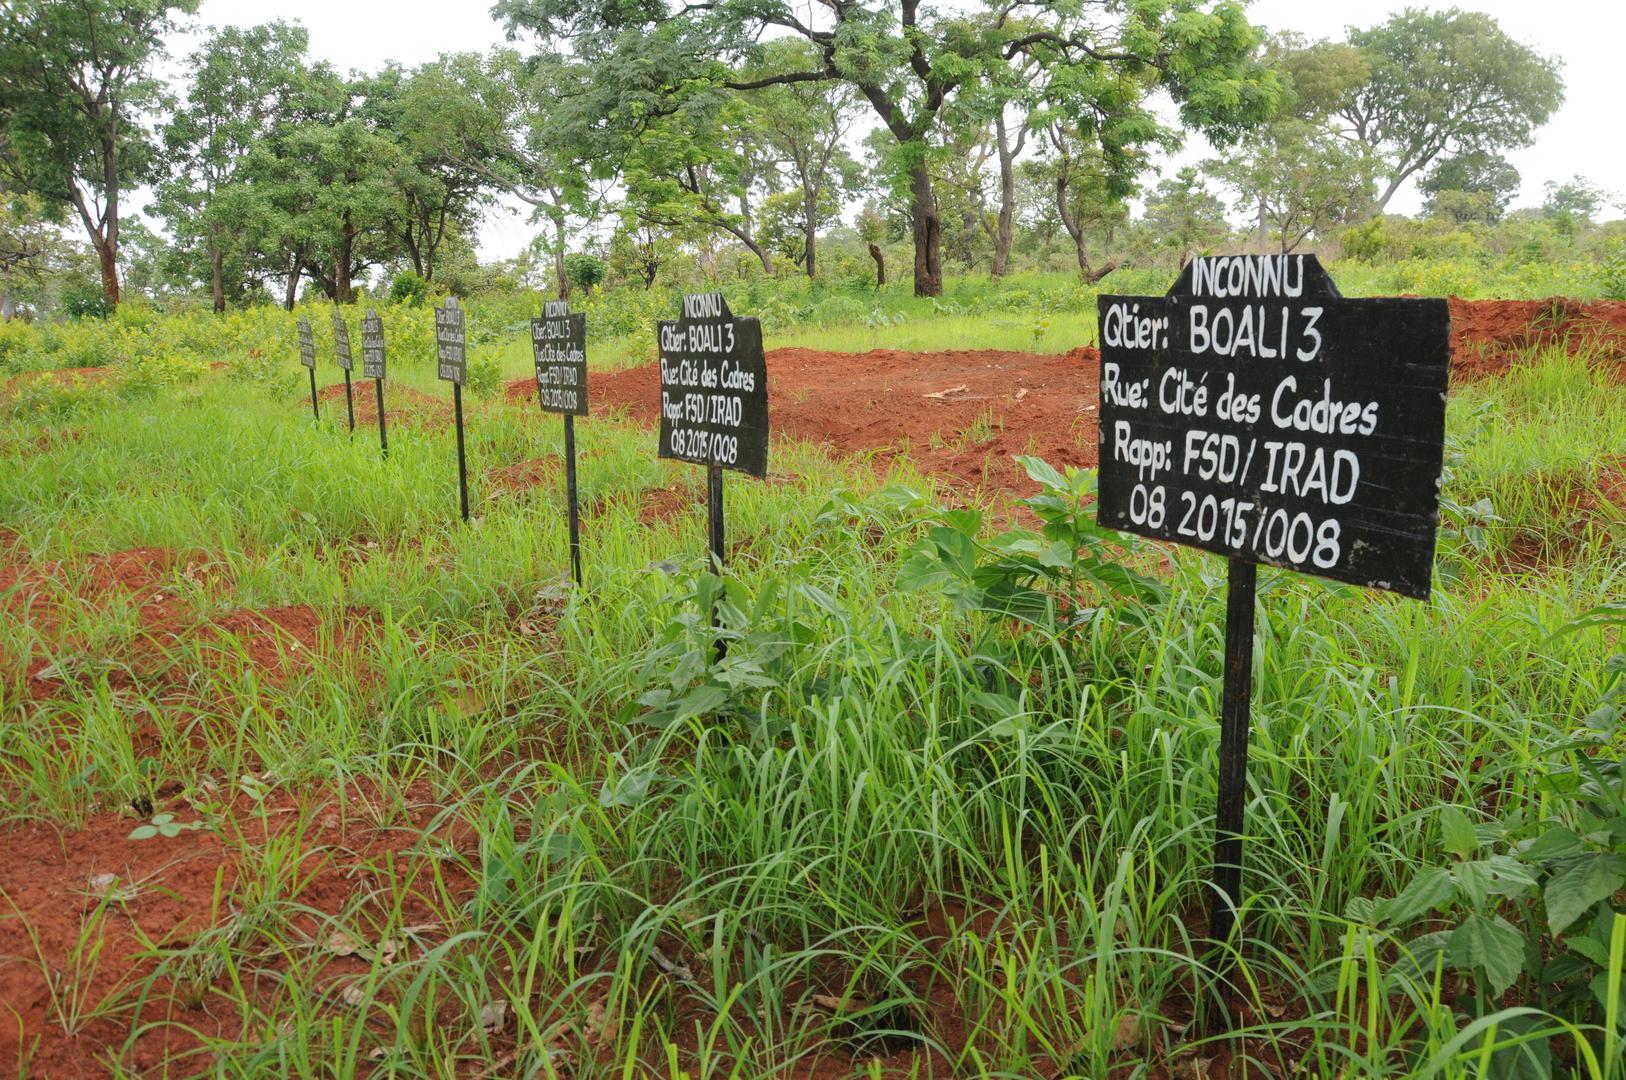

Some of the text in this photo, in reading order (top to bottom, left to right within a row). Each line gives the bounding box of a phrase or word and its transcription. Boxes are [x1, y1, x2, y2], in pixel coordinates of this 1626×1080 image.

[1192, 255, 1303, 297] INCONNU
[683, 293, 722, 319] INCONNU
[661, 323, 735, 353] Qtier: BOALI 3
[1103, 303, 1324, 362] Qtier: BOALI 3
[660, 358, 755, 392] Rue: Cité des Cadres
[662, 392, 684, 427] Rapp:
[1103, 362, 1378, 436] Rue: Cité des Cadres
[671, 428, 738, 464] 08 2015/008
[1114, 420, 1172, 481] Rapp:
[1129, 485, 1341, 568] 08 2015/008
